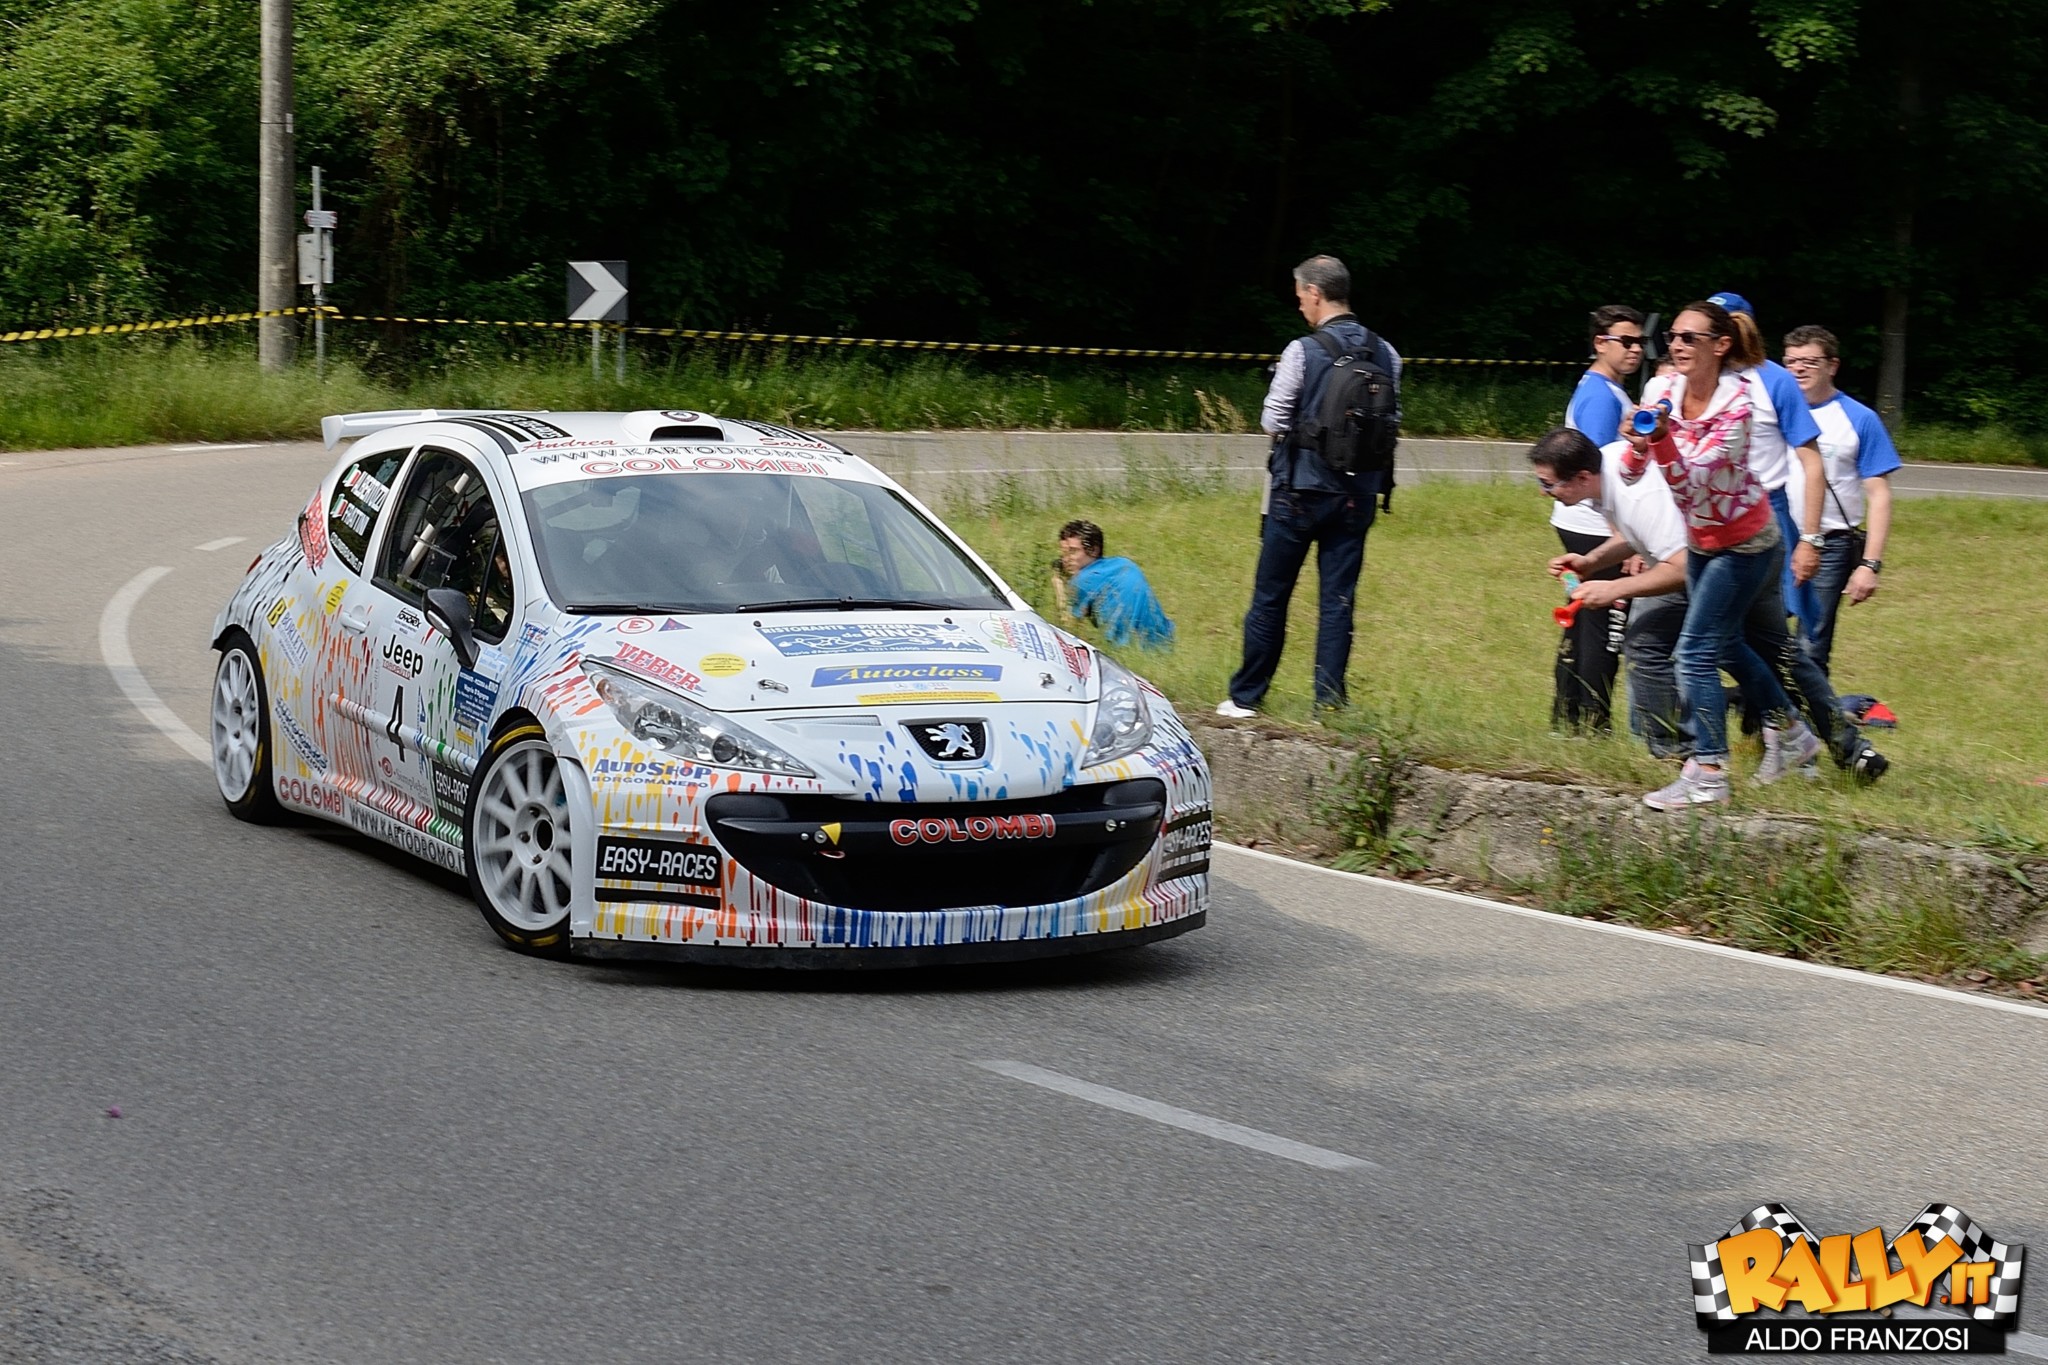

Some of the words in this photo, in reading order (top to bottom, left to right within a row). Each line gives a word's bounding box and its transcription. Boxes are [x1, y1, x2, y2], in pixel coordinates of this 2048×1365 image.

[521, 438, 617, 453] Andrea
[759, 438, 832, 451] Sarah
[530, 445, 844, 465] WWW.KARTODROMO.IT
[580, 457, 829, 476] COLOMBI
[762, 624, 844, 633] RISTORANTE
[861, 629, 926, 637] RINO
[383, 635, 423, 678] Jeep
[615, 643, 702, 690] VEBER
[834, 664, 984, 680] Autoclass
[386, 684, 405, 762] 4
[592, 776, 708, 788] BORGOMANERO
[279, 776, 345, 818] COLOMBI
[889, 813, 1056, 846] COLOMBI
[602, 846, 717, 880] EASY-RACES
